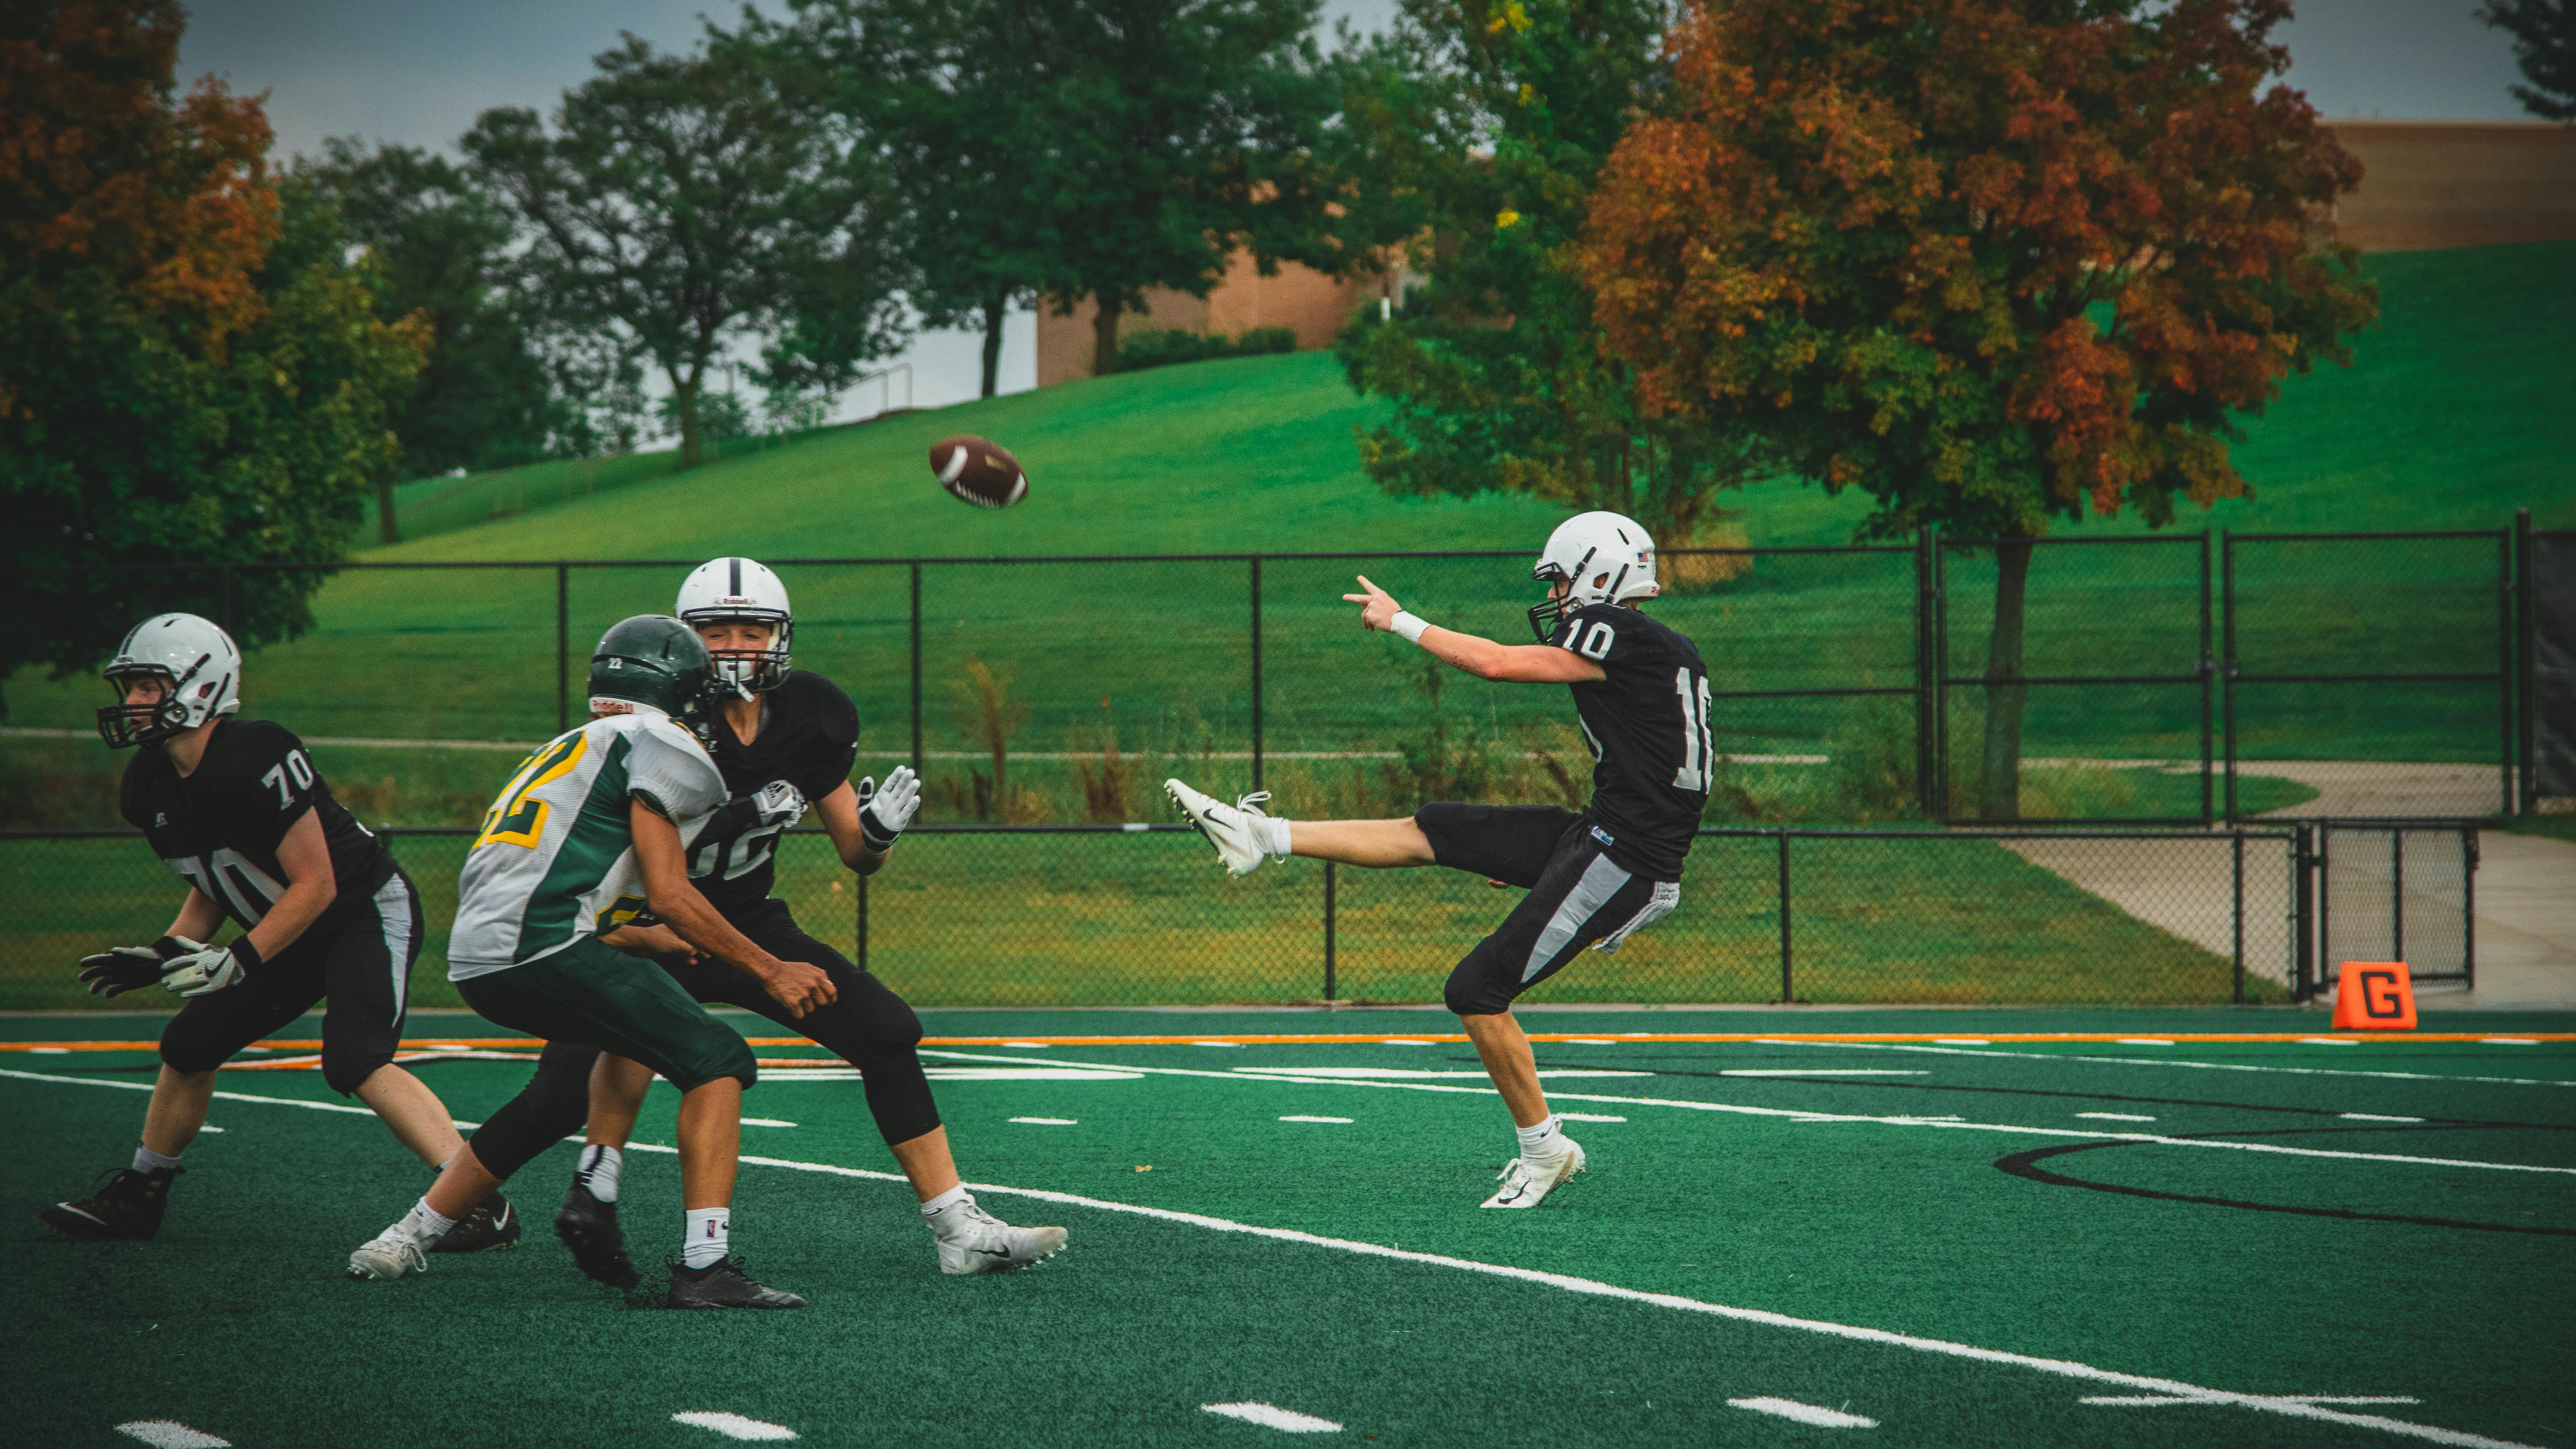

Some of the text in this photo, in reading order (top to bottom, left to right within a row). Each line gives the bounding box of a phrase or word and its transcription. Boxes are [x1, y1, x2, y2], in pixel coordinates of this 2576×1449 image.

[1563, 618, 1615, 660] 10
[608, 657, 623, 669] 22
[261, 749, 314, 811] 70
[2360, 972, 2402, 1018] G
